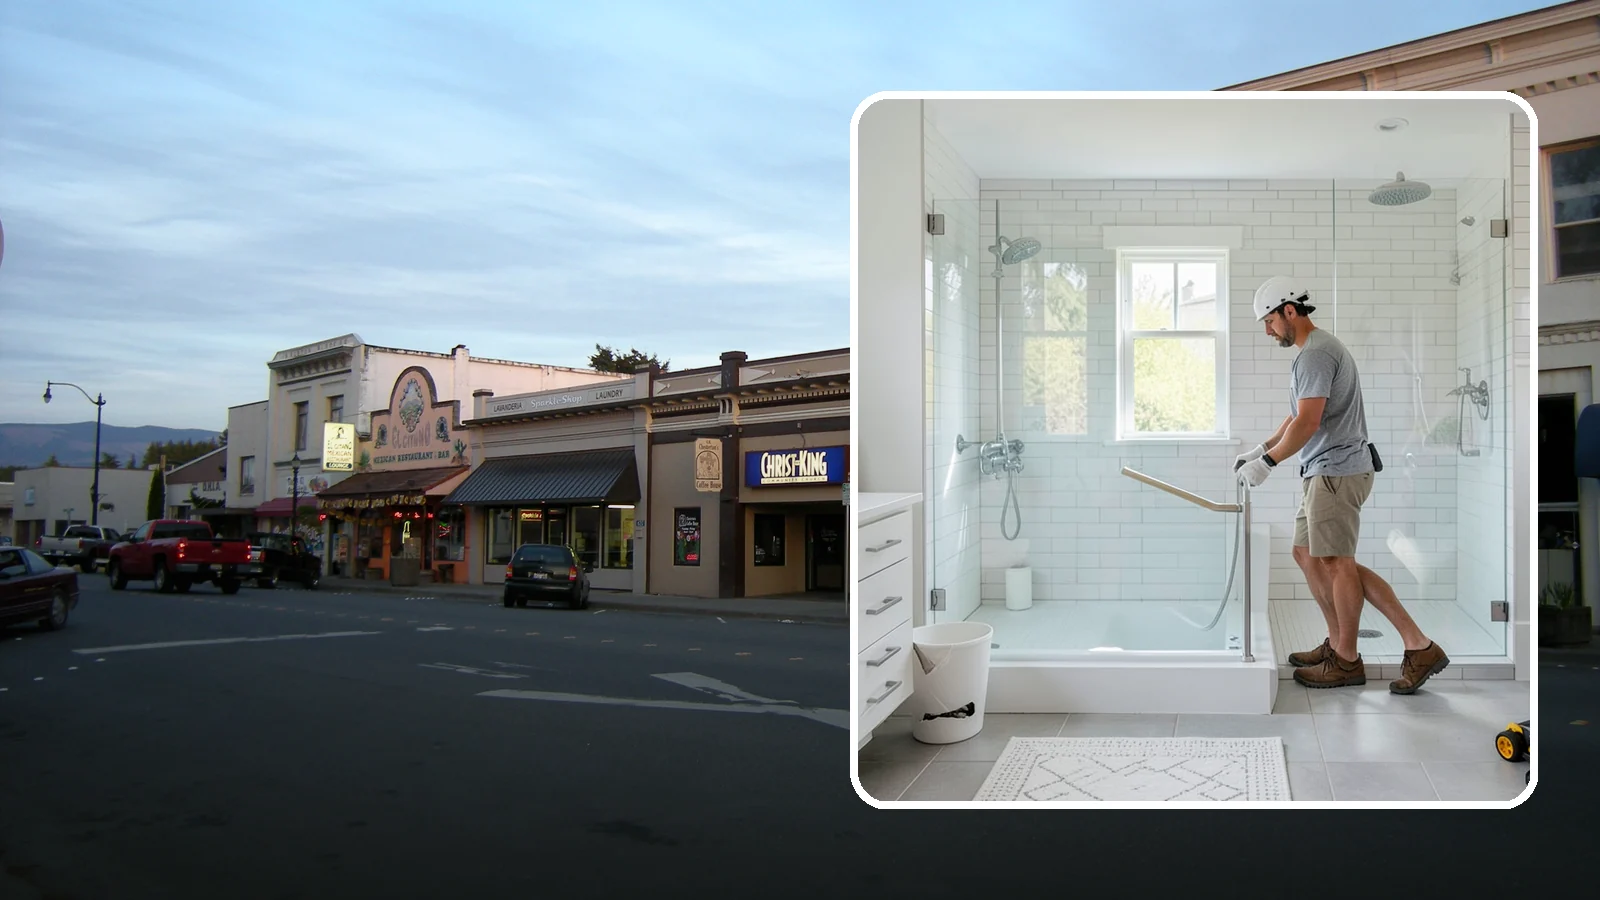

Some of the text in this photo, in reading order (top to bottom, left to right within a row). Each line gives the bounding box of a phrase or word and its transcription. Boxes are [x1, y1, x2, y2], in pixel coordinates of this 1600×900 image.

[562, 394, 583, 405] Shop
[595, 389, 624, 400] LAUNDRY
[493, 402, 523, 413] LAVANDERIA
[373, 454, 396, 464] MEXICAN
[397, 451, 433, 462] RESTAURANT
[437, 449, 450, 459] BAR
[761, 450, 827, 478] CHRIST KING
[696, 480, 709, 489] Coffee
